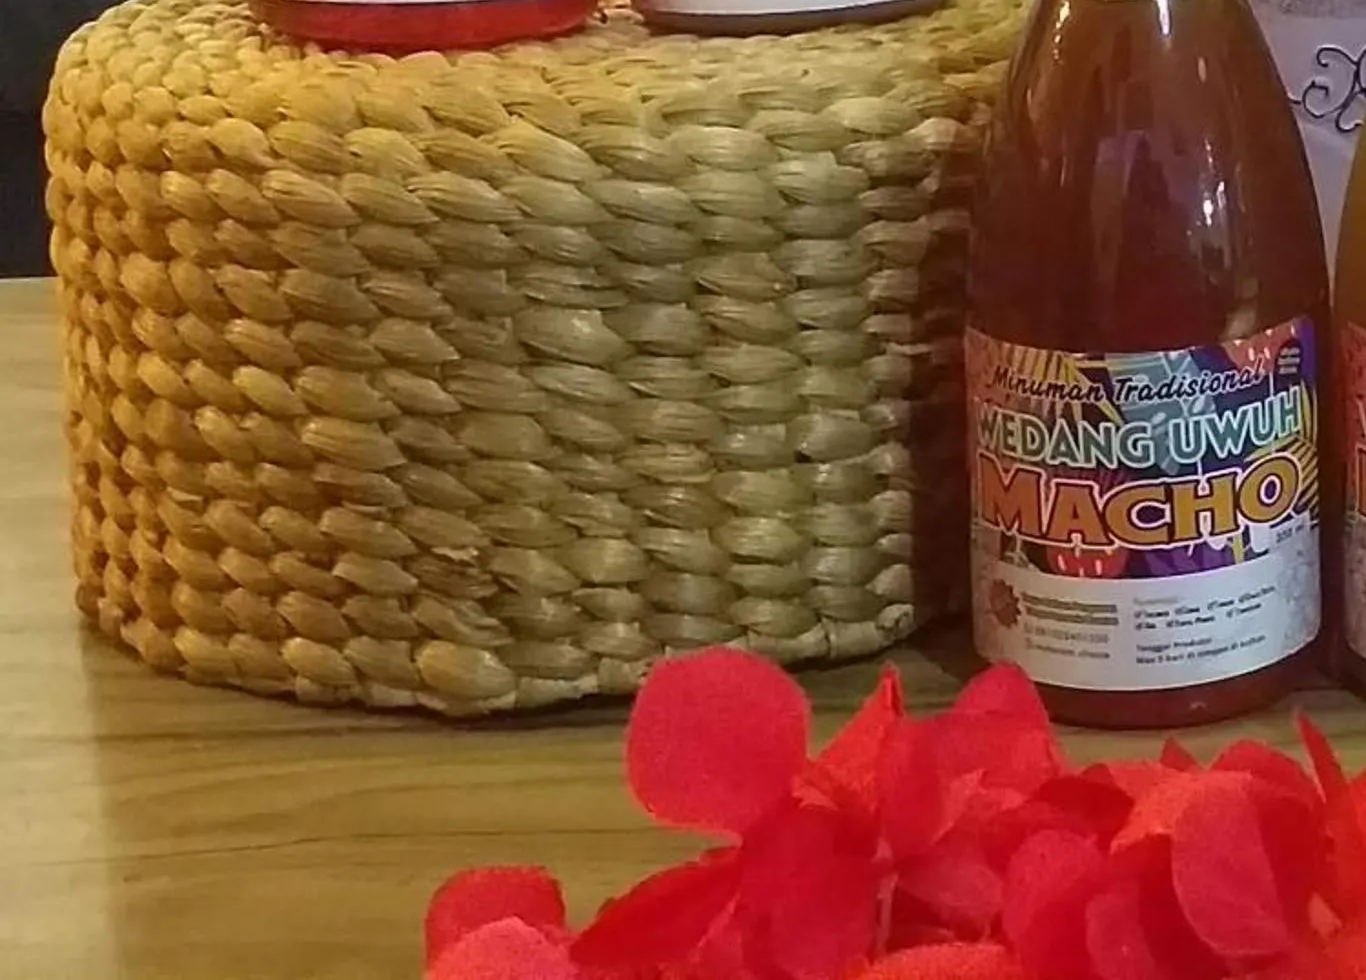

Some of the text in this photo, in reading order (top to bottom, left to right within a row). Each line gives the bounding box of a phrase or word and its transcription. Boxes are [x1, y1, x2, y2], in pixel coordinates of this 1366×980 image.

[987, 365, 1104, 403] Minuman
[1114, 360, 1266, 402] Tradisional
[975, 384, 1302, 470] WEDANG UWUH
[978, 451, 1303, 550] MACHO
